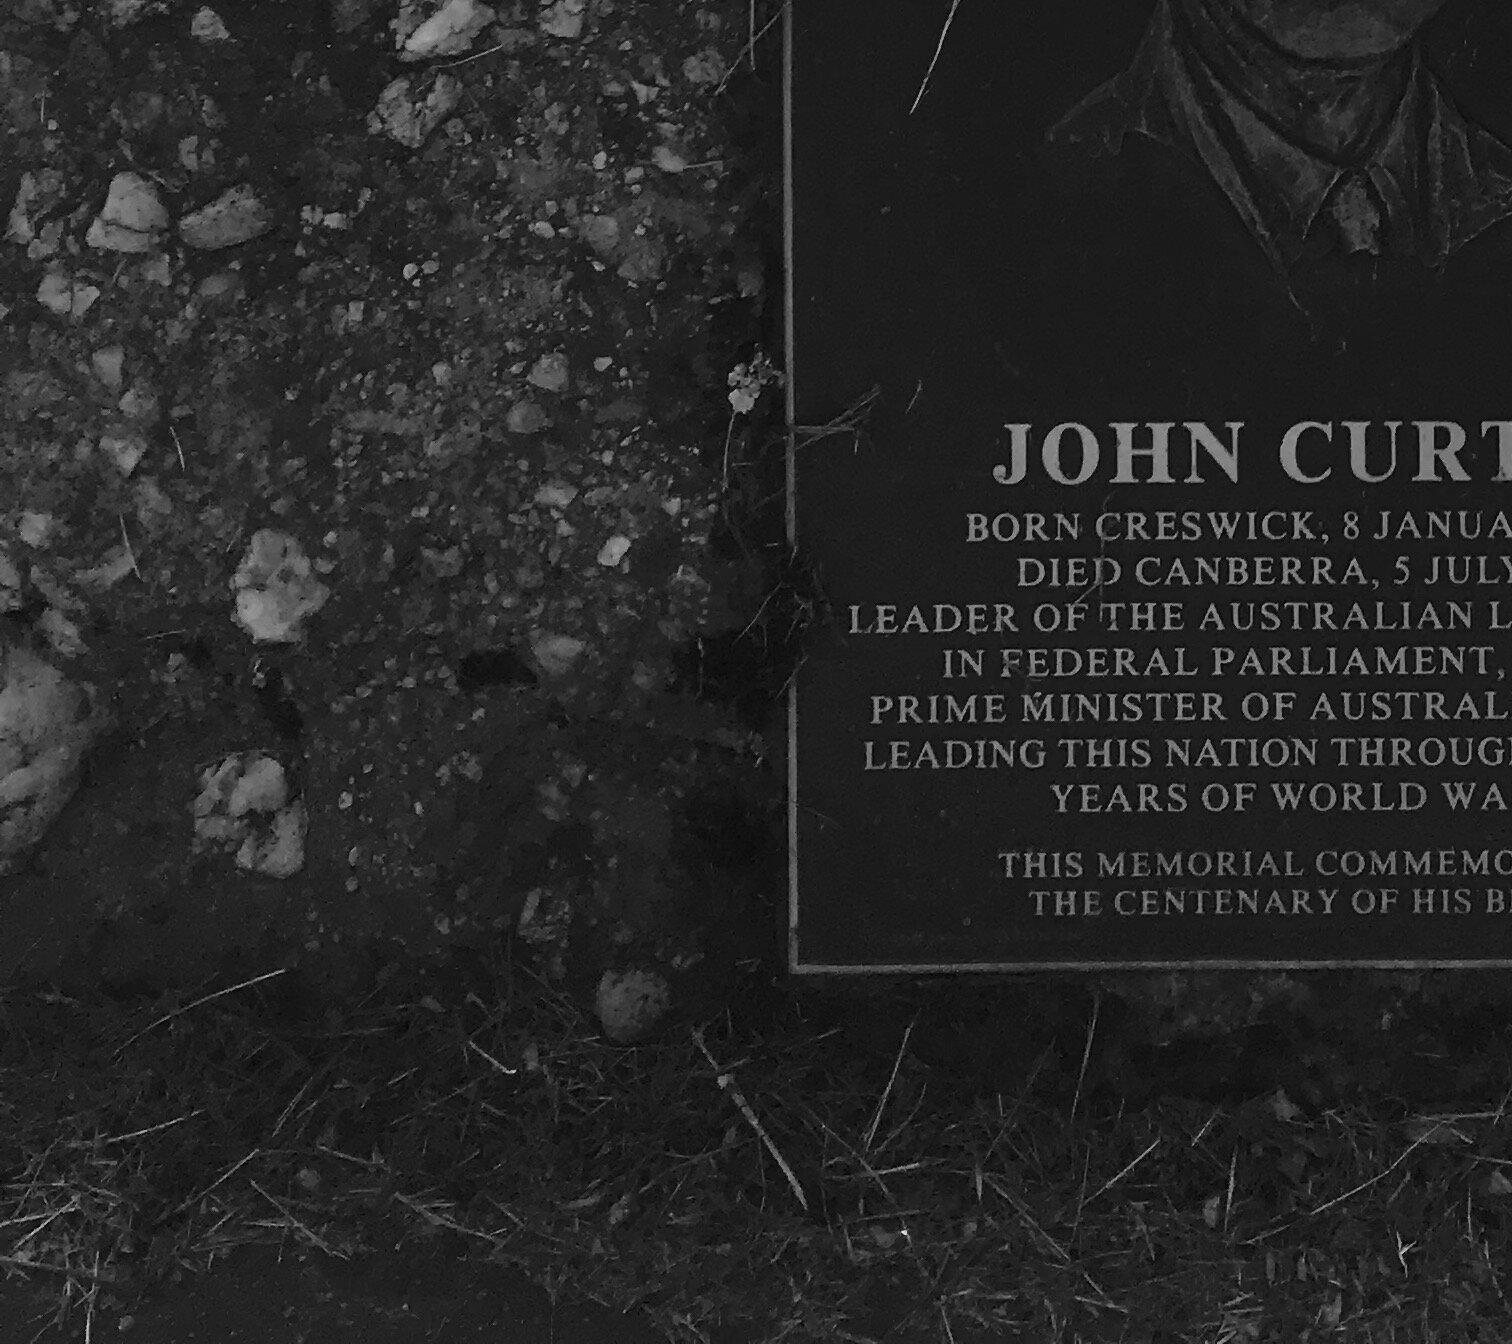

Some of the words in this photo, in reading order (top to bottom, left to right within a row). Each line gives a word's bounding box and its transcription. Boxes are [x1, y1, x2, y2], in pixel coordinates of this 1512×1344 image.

[992, 421, 1245, 486] JOHN
[965, 512, 1080, 543] BORN
[1095, 510, 1329, 545] CRESWICK,
[1343, 511, 1360, 540] 8
[1017, 557, 1122, 587] DIED
[1134, 556, 1380, 590] CANBERRA,
[1393, 555, 1410, 585] 5
[848, 603, 1019, 634] LEADER
[1033, 602, 1089, 633] OF
[1102, 602, 1185, 632] THE
[1199, 601, 1473, 631] AUSTRALIAN
[942, 649, 985, 679] IN
[999, 647, 1199, 678] FEDERAL
[1211, 646, 1505, 681] PARLIAMENT,
[870, 694, 1007, 725] PRIME
[1020, 693, 1228, 723] MINISTER
[1241, 691, 1297, 722] OF
[864, 739, 1047, 771] LEADING
[1057, 738, 1152, 768] THIS
[1164, 737, 1319, 768] NATION
[1049, 782, 1188, 813] YEARS
[1201, 782, 1257, 812] OF
[1270, 782, 1428, 812] WORLD
[997, 851, 1083, 879] THIS
[1097, 850, 1304, 877] MEMORIAL
[1028, 890, 1101, 916] THE
[1114, 889, 1339, 916] CENTENARY
[1351, 888, 1399, 915] OF
[1413, 888, 1472, 914] HIS
